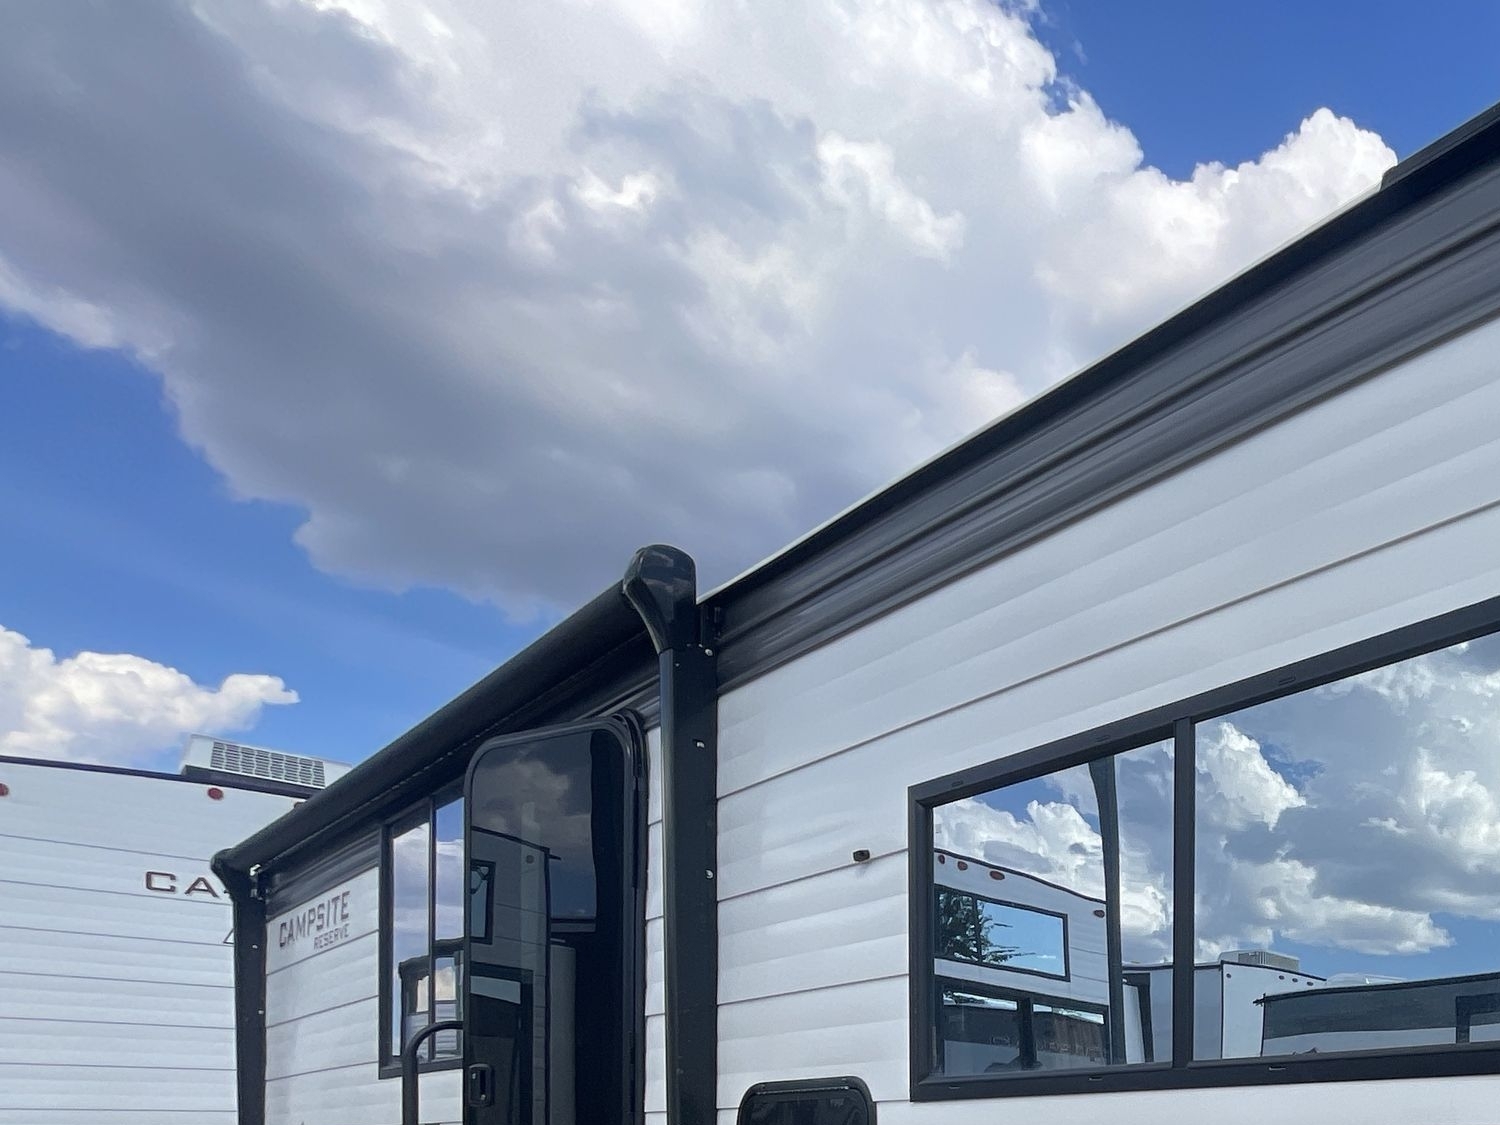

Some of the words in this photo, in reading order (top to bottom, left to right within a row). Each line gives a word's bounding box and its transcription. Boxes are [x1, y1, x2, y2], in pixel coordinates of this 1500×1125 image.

[146, 871, 227, 899] CA
[279, 890, 351, 948] CAMPSITE
[314, 923, 350, 950] RESERVE
